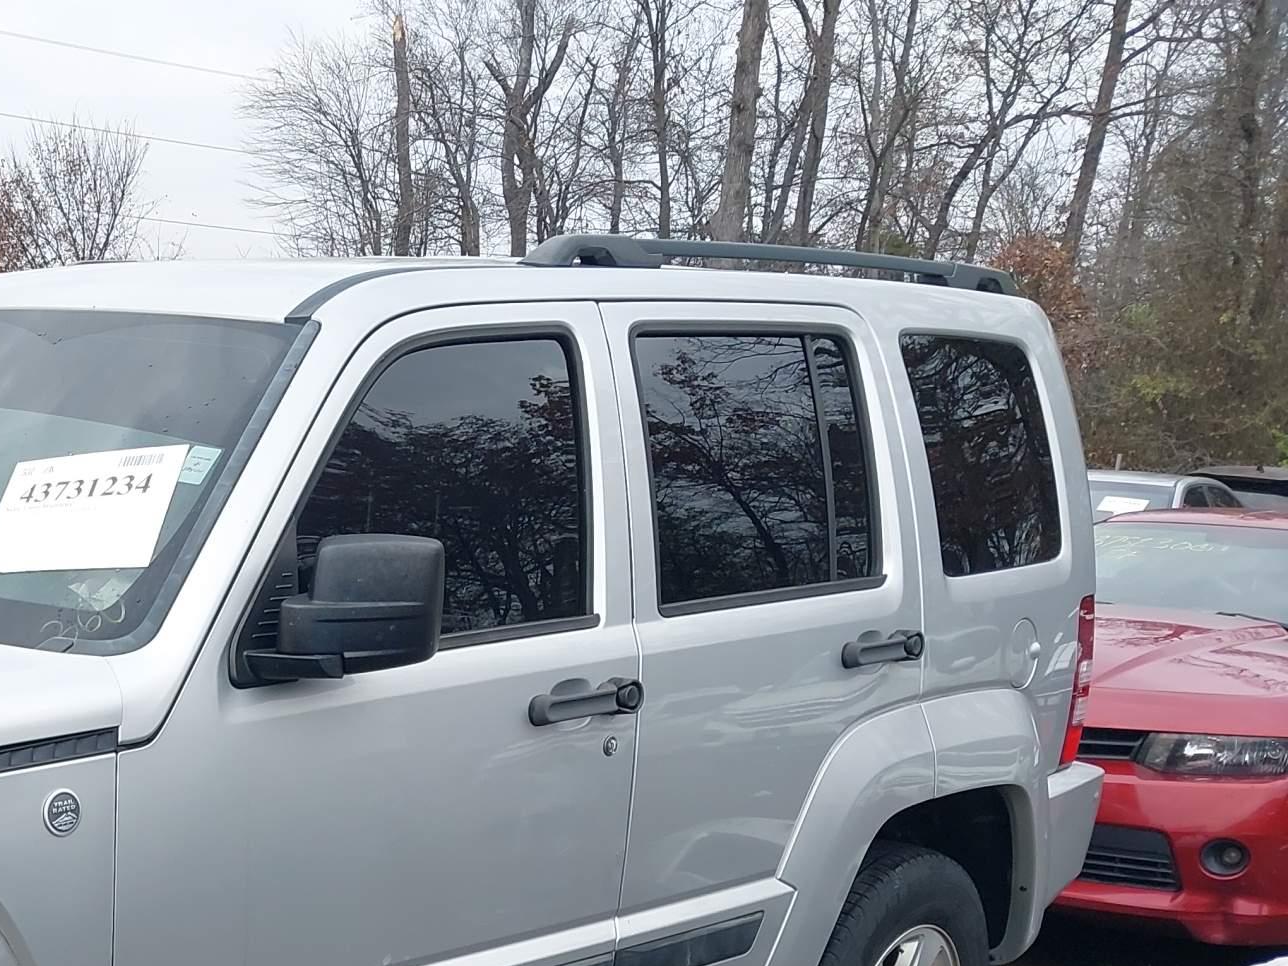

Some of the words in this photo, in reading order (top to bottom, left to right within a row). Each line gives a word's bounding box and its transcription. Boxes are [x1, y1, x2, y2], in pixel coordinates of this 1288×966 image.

[19, 472, 154, 504] 43731234
[52, 798, 75, 808] TRAIL
[52, 804, 76, 814] RATED
